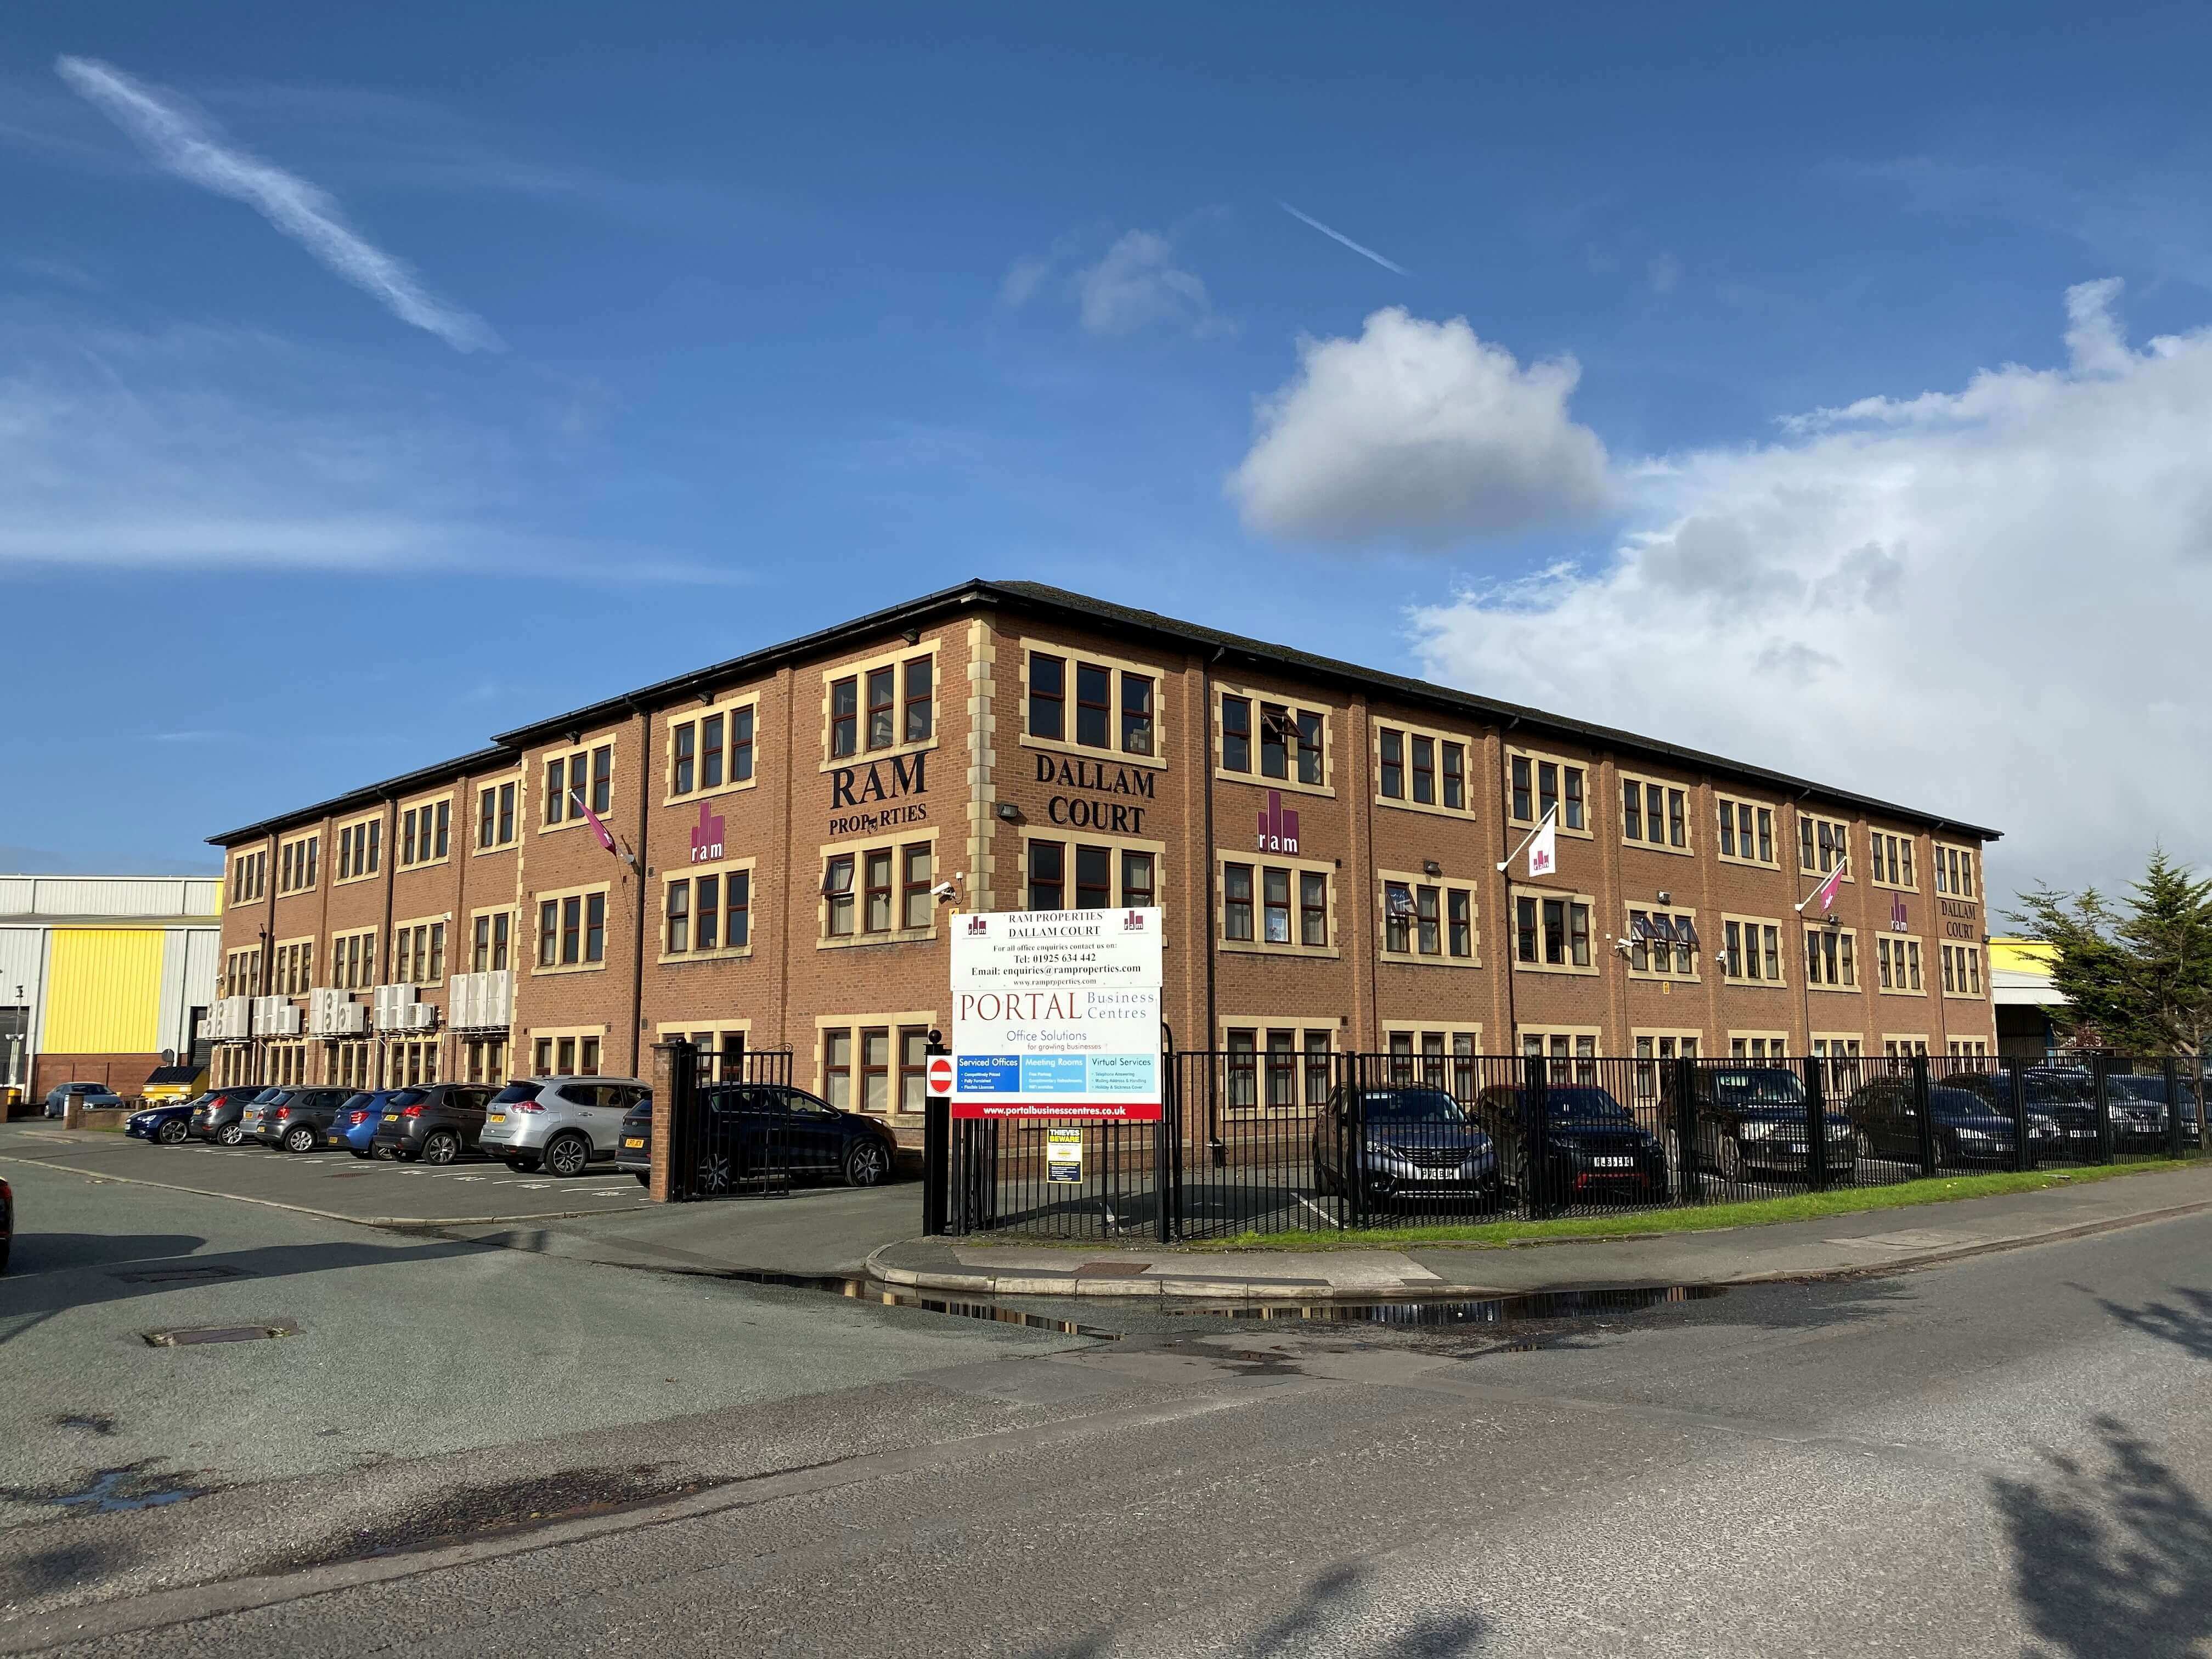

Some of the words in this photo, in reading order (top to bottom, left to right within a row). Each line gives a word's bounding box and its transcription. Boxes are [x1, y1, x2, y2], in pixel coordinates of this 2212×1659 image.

[830, 752, 928, 810] RAM
[1035, 753, 1155, 799] DALLAM
[829, 803, 927, 836] PROPRTIES
[1048, 795, 1146, 833] COURT
[1259, 834, 1298, 853] ram
[691, 843, 722, 861] ram
[1941, 900, 1976, 920] DALLAM
[1009, 914, 1032, 923] RAM
[1036, 911, 1103, 922] PROPERTIES
[1009, 927, 1057, 937] DALLAM
[1060, 926, 1101, 936] COURT
[1891, 919, 1908, 932] ram
[1946, 922, 1974, 939] COURT
[1037, 943, 1068, 952] enquiries
[1014, 955, 1030, 963] Tel:
[1032, 954, 1059, 963] 01925
[1062, 953, 1077, 962] 634
[1080, 953, 1096, 961] 442
[972, 967, 1001, 976] Email:
[1003, 964, 1141, 977] enquiries@ramproperties.com
[1014, 978, 1097, 986] www.ramproperties.com
[1088, 992, 1154, 1003] Business
[960, 992, 1083, 1020] PORTAL
[1088, 1007, 1147, 1019] Centres
[1007, 1030, 1037, 1041] Office
[1040, 1029, 1087, 1041] Solutions
[959, 1058, 990, 1066] Serviced
[992, 1057, 1018, 1066] Offices
[1025, 1057, 1056, 1068] Meeting
[1058, 1058, 1083, 1066] Rooms
[1092, 1057, 1117, 1066] Virtual
[1120, 1058, 1151, 1066] Services
[983, 1105, 1126, 1117] www.portalbusinesscentres.co.uk
